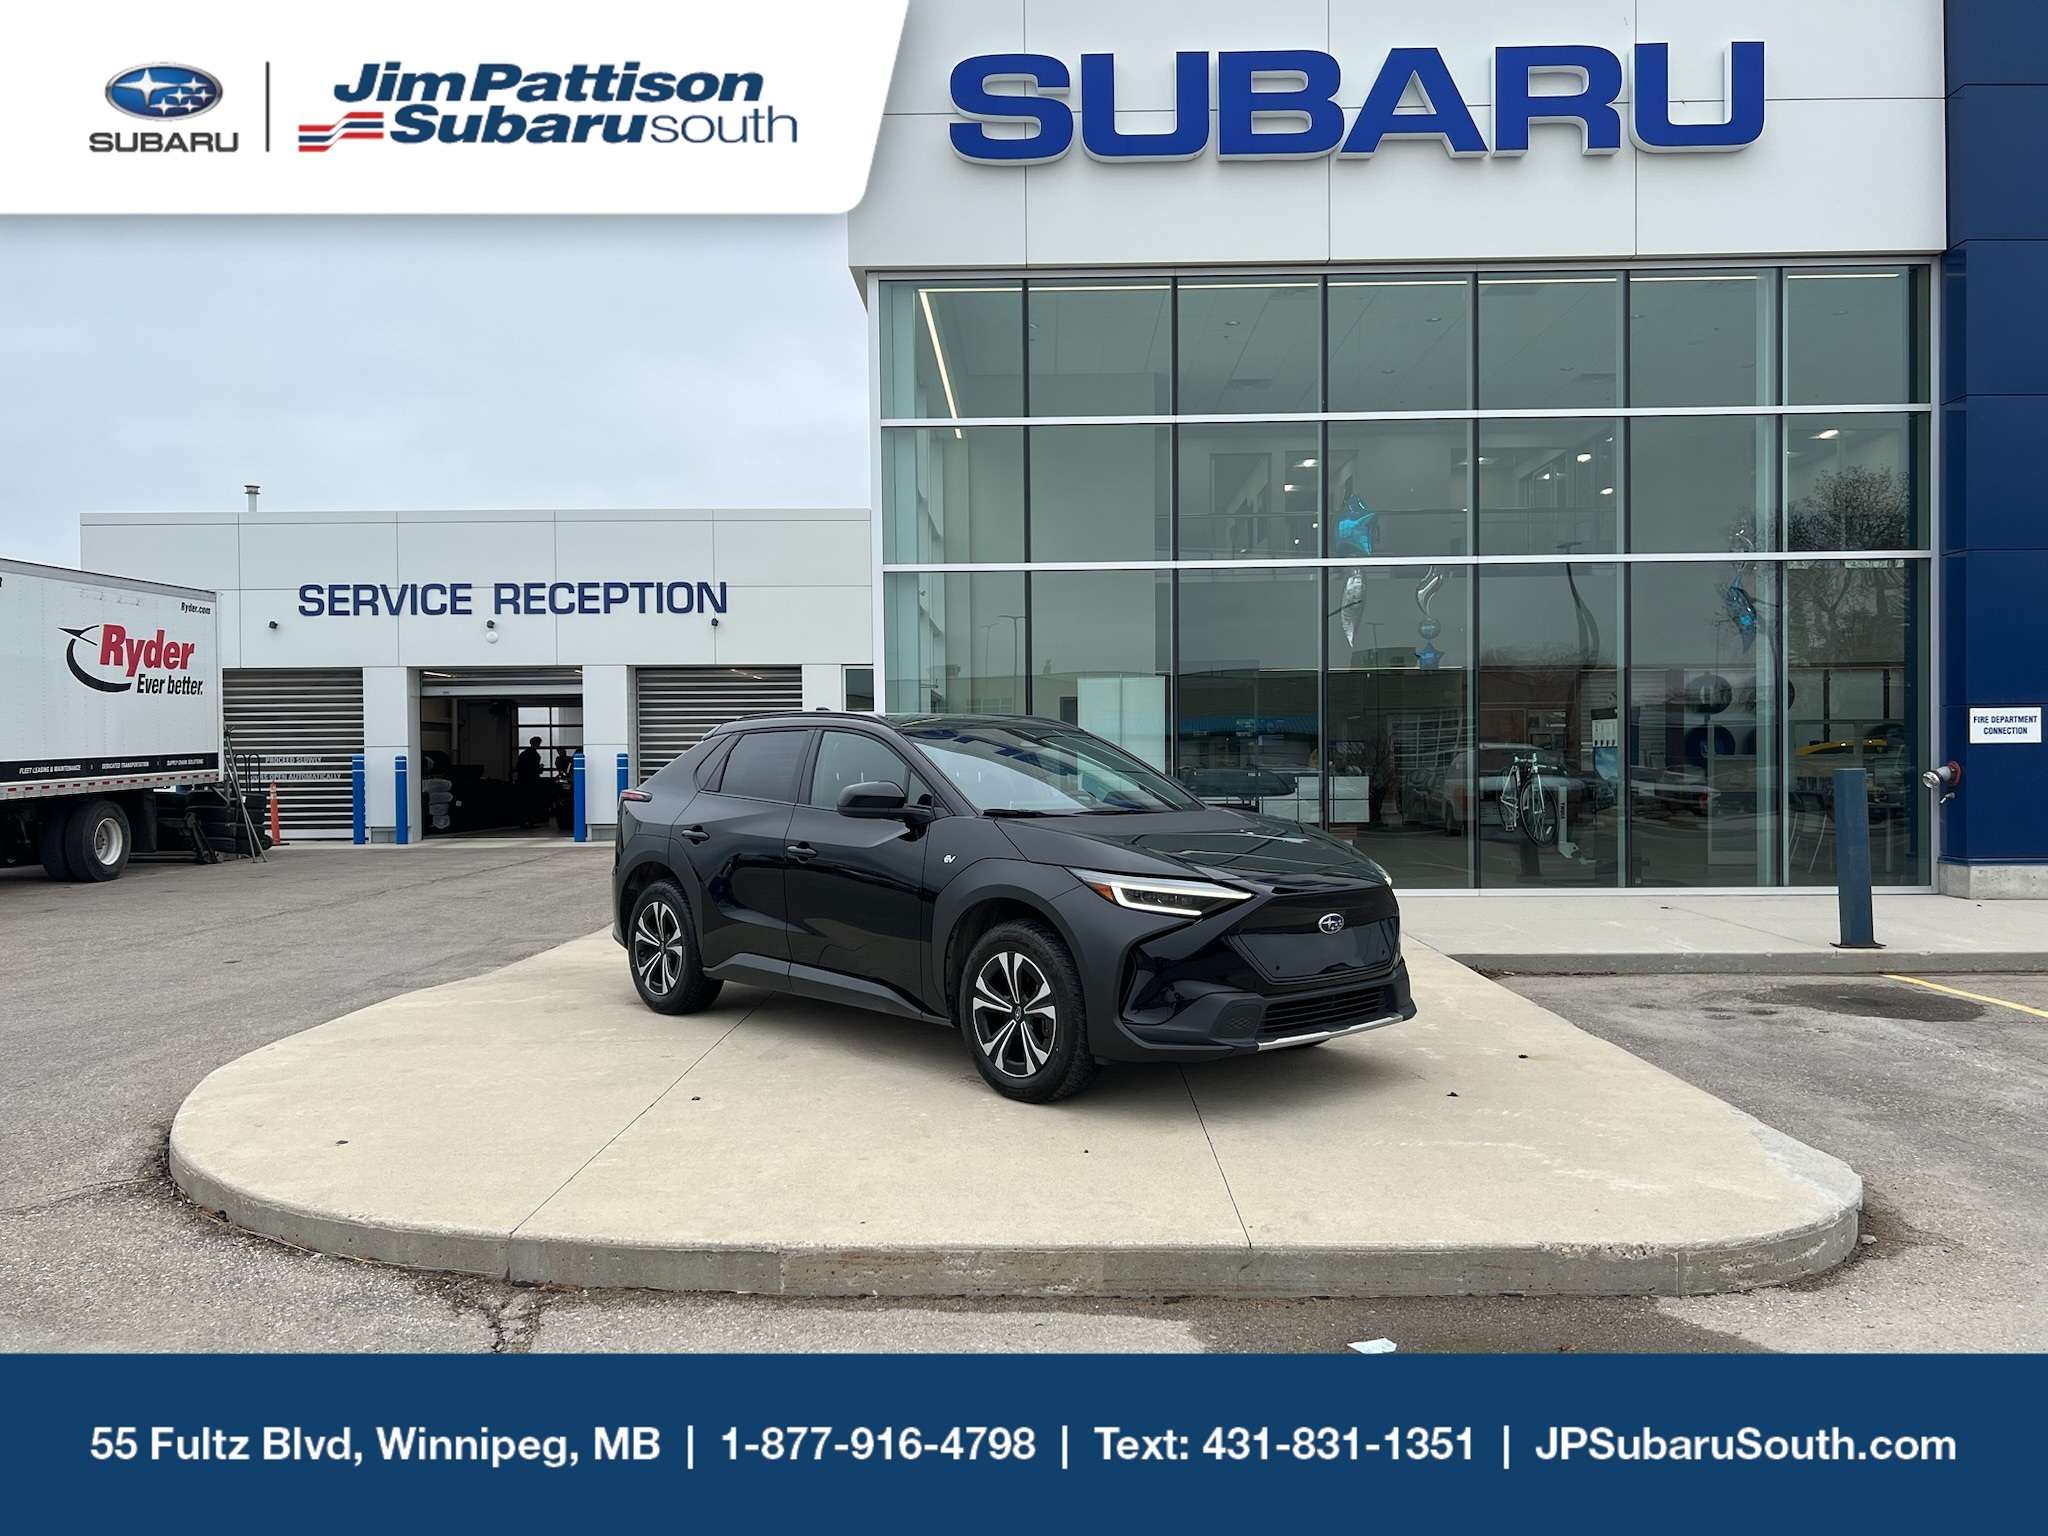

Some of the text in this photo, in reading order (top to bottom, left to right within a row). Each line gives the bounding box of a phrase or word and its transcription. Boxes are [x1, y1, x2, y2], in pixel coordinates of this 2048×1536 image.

[949, 41, 1766, 162] SUBARU
[180, 601, 212, 615] Ryder.com
[298, 581, 727, 617] SERVICE RECEPTION
[99, 623, 195, 678] Ryder
[136, 673, 204, 696] Ever better.
[1973, 715, 2039, 724] FIRE DEPARTMENT
[1983, 726, 2028, 736] CONNECTION
